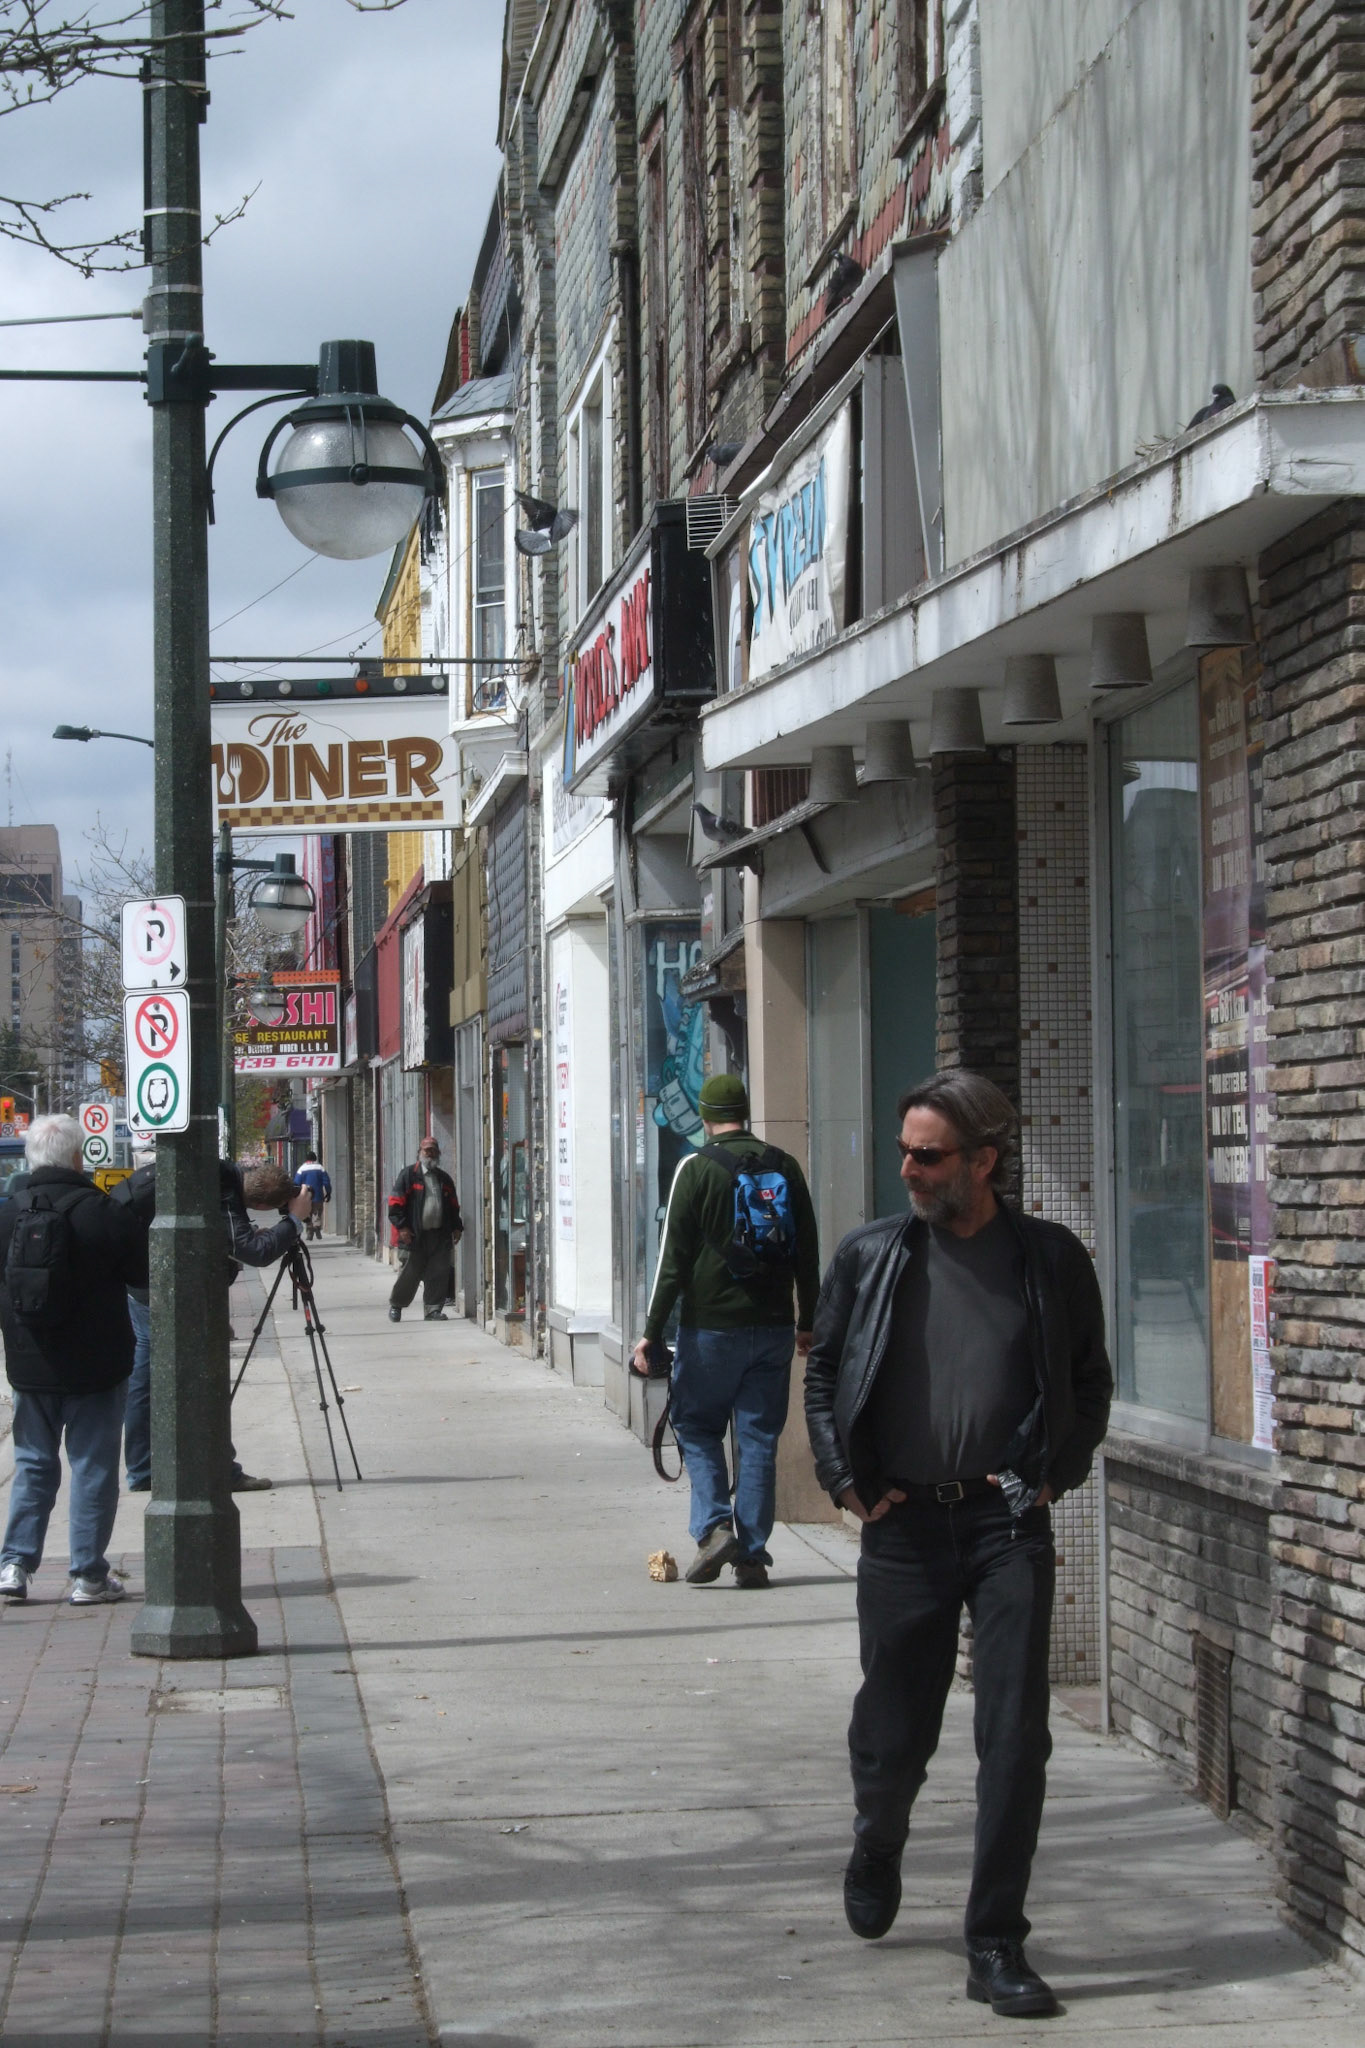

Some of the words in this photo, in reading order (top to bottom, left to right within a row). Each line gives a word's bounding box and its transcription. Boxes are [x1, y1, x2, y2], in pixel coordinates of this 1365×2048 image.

[248, 712, 307, 747] The
[211, 737, 443, 804] DINER
[245, 991, 336, 1028] SHI
[257, 1030, 328, 1042] RESTAURANT
[280, 1043, 298, 1053] UNDER
